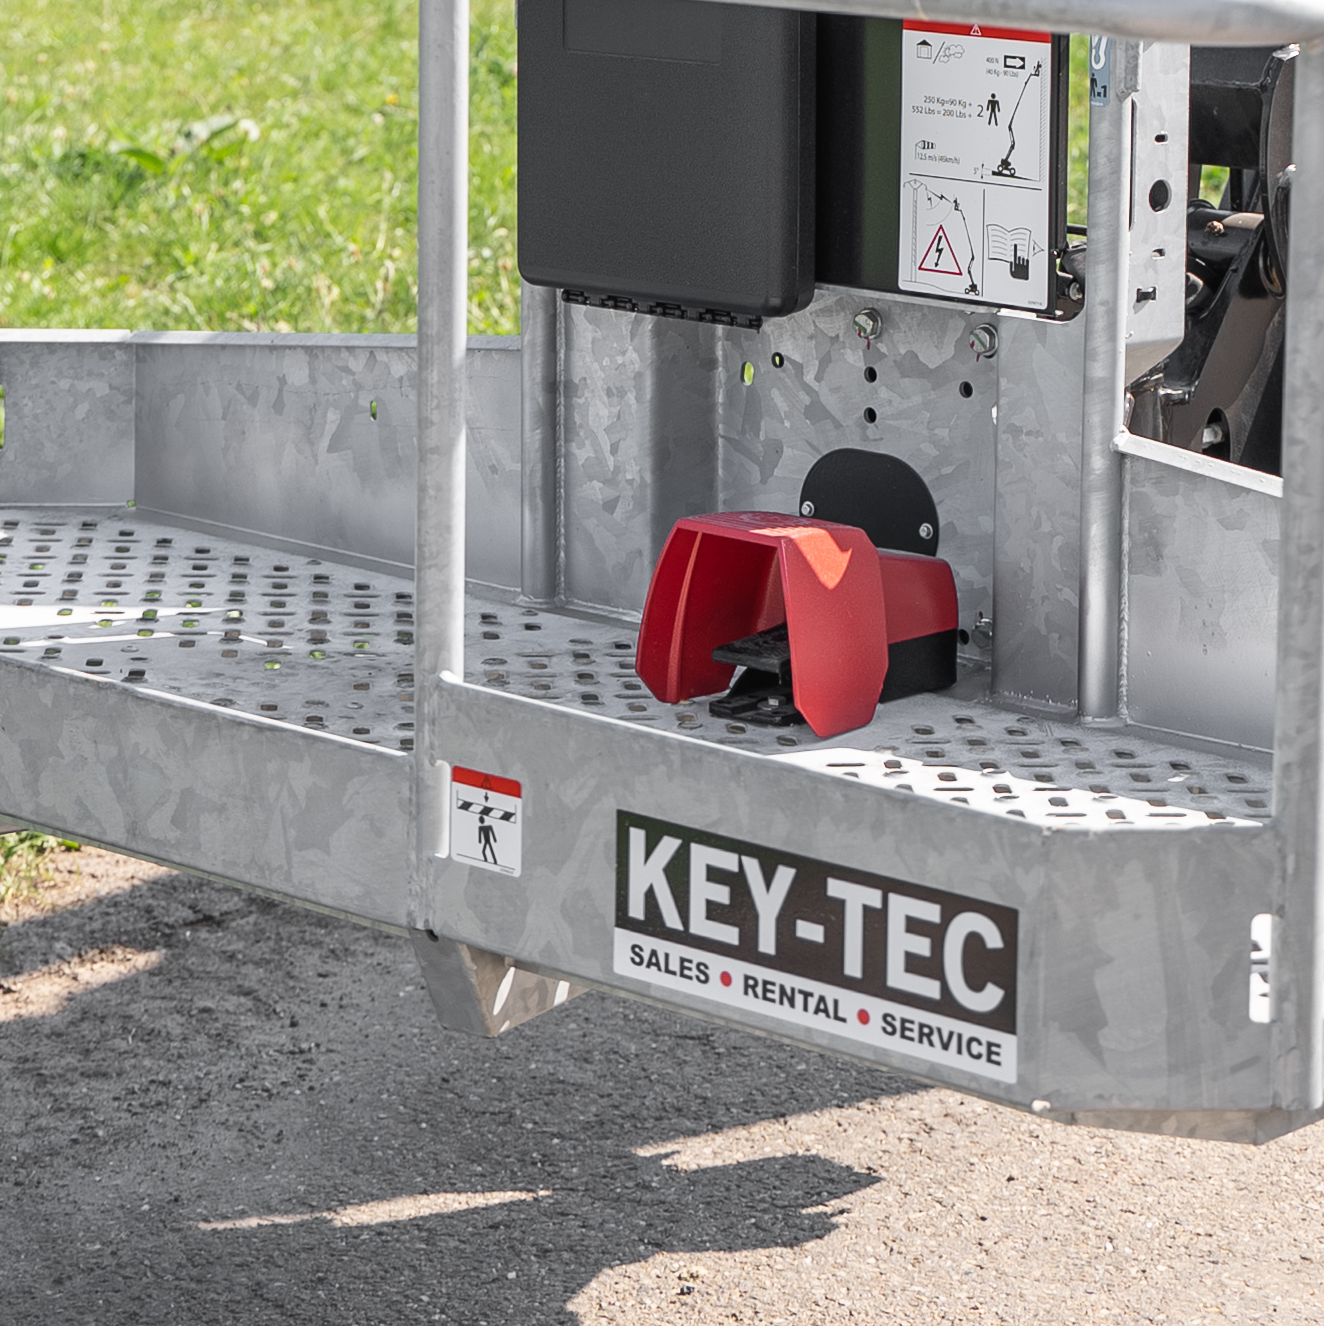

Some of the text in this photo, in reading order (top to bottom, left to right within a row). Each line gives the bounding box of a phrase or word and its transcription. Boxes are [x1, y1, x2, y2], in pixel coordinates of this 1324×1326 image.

[923, 95, 935, 104] 250
[958, 99, 966, 109] Kg
[911, 105, 923, 114] 552
[924, 106, 935, 115] Lbs
[942, 108, 954, 117] 200
[956, 110, 966, 119] Lbs
[977, 104, 984, 118] 2
[628, 826, 1005, 1013] KEY-TEC
[629, 944, 1003, 1067] SALES RENTAL SERVICE
